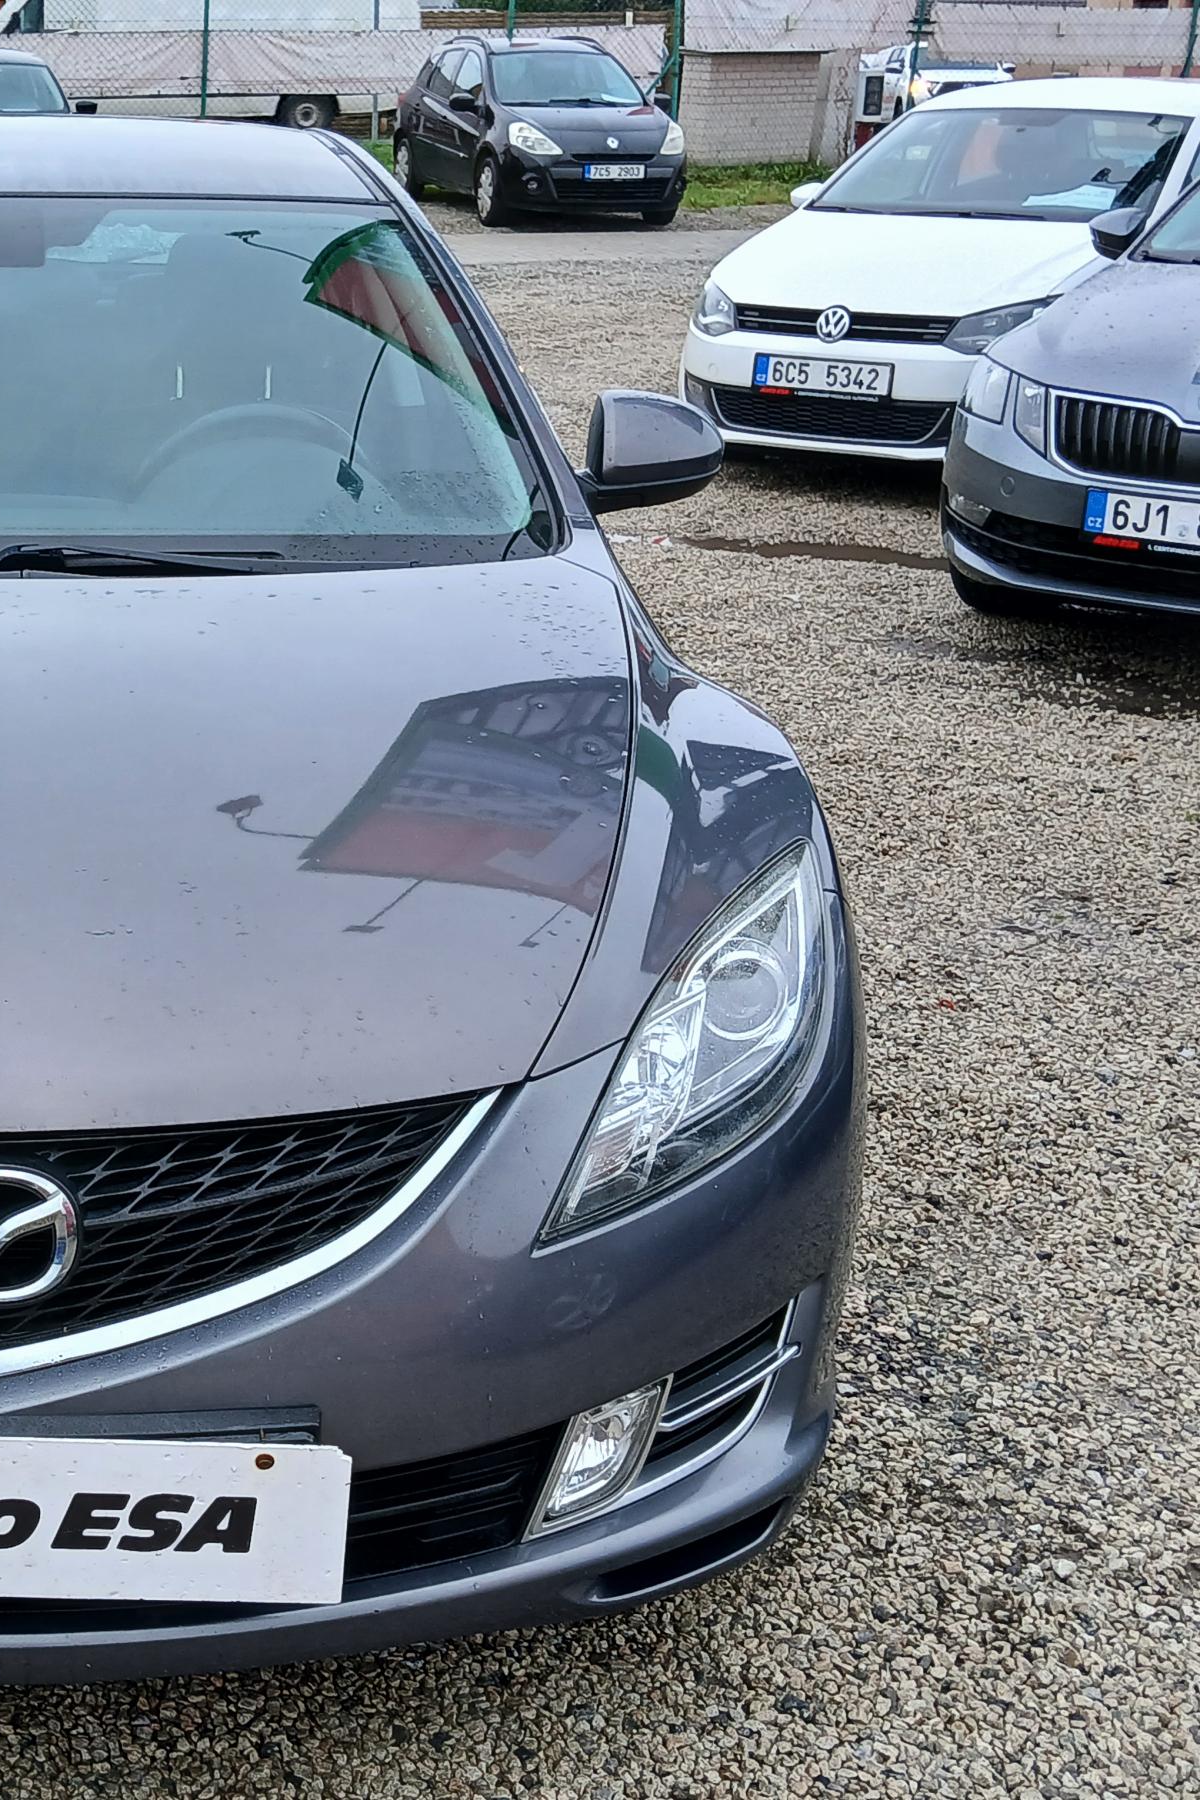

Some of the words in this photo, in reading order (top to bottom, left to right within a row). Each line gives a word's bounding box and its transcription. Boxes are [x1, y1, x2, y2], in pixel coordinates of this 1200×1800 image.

[593, 166, 611, 177] 7C5
[617, 166, 640, 177] 2903
[772, 360, 810, 385] 6C5
[825, 364, 879, 391] 5342
[1087, 516, 1103, 528] CZ
[1112, 499, 1169, 536] 6J1
[50, 1492, 258, 1554] ESA
